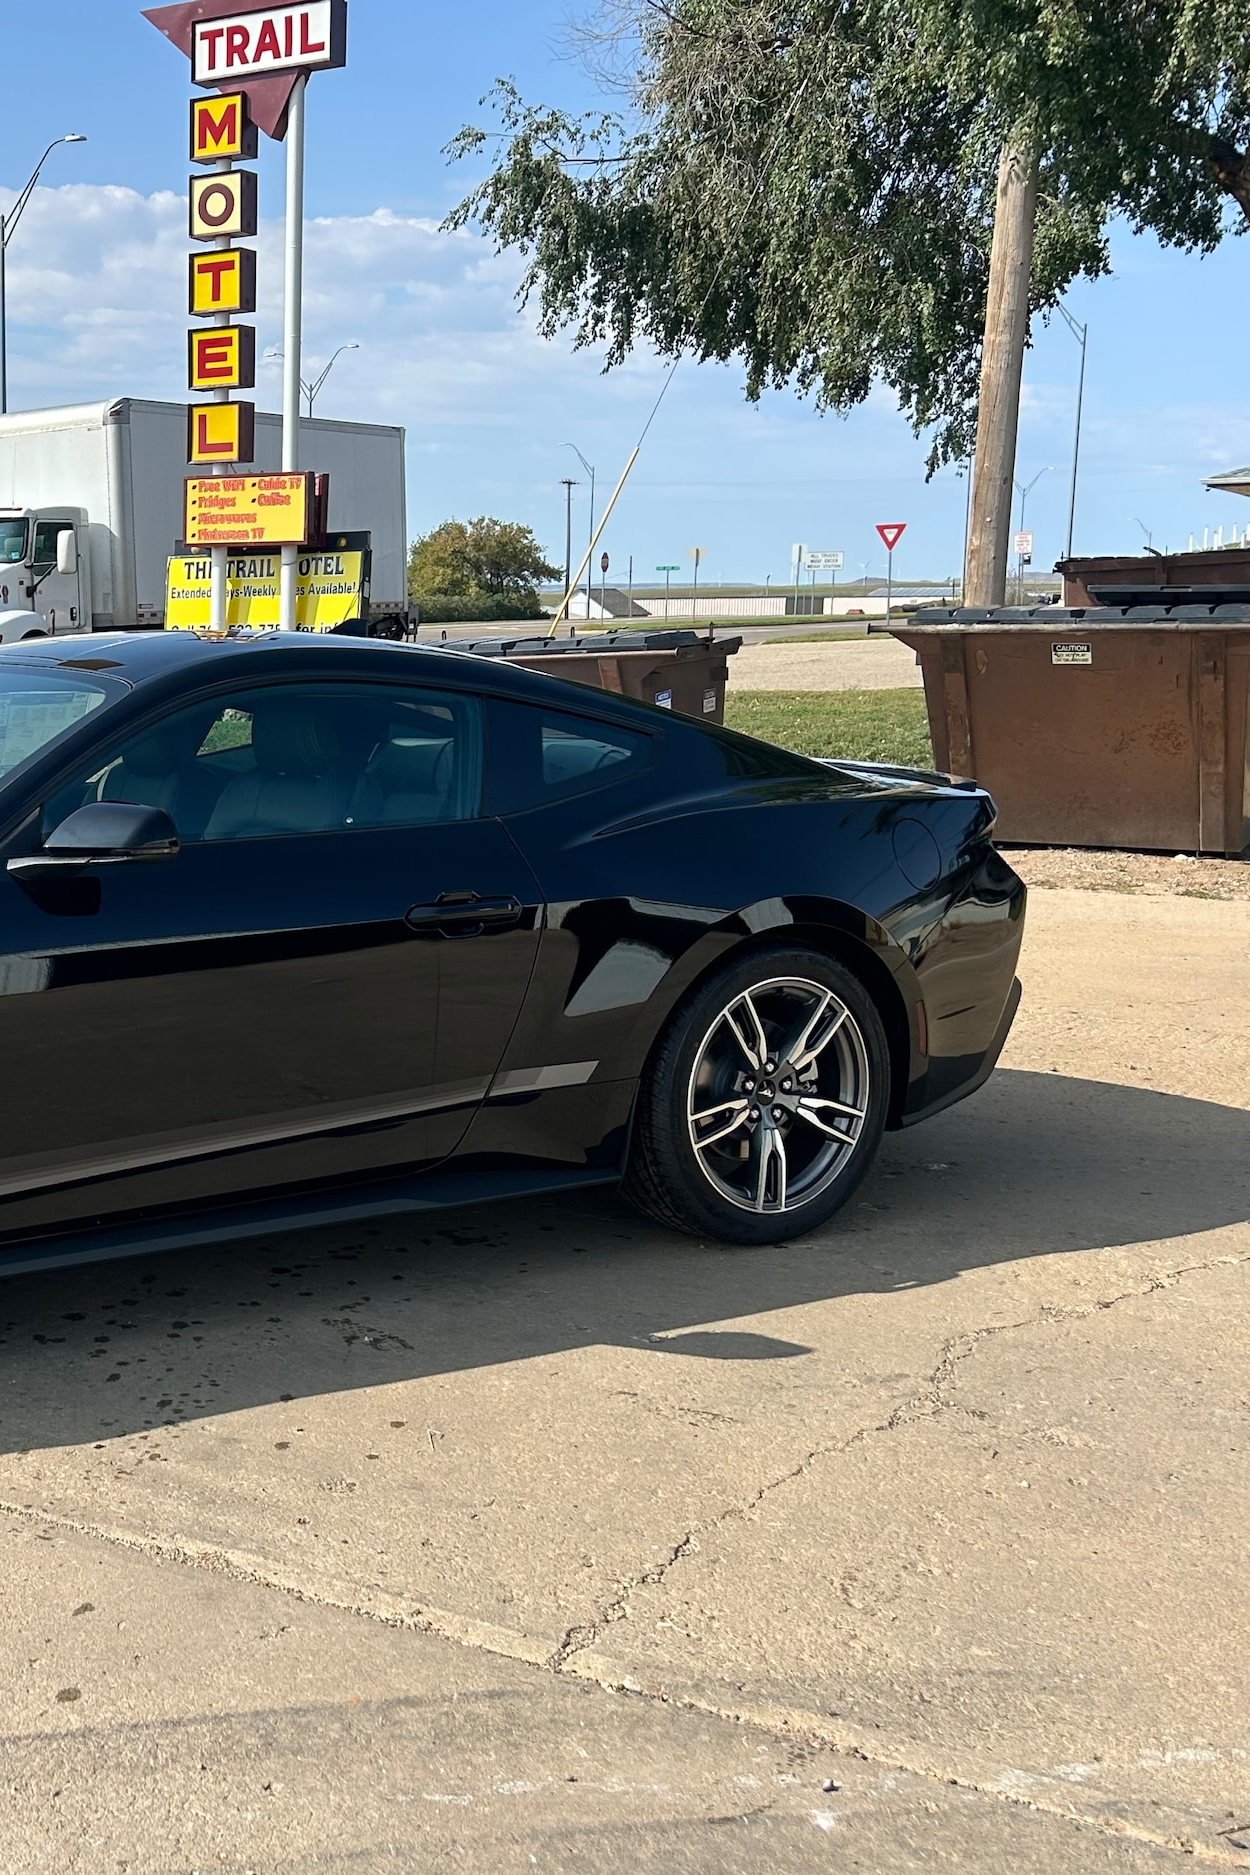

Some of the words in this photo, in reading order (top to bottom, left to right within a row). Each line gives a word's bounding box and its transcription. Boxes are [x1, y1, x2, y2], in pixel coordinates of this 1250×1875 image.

[200, 12, 325, 71] TRAIL
[196, 103, 237, 454] MOTEL
[198, 480, 220, 492] Free
[257, 477, 287, 490] Cable
[289, 477, 302, 490] TV
[198, 496, 236, 510] Fridges
[257, 492, 291, 506] Coffee
[198, 512, 257, 525] Microwaves
[251, 527, 265, 540] TV
[184, 561, 212, 580] TH
[225, 559, 275, 578] TRAIL
[298, 556, 344, 576] OTEL
[171, 587, 212, 599] Extended
[308, 581, 356, 595] Available!
